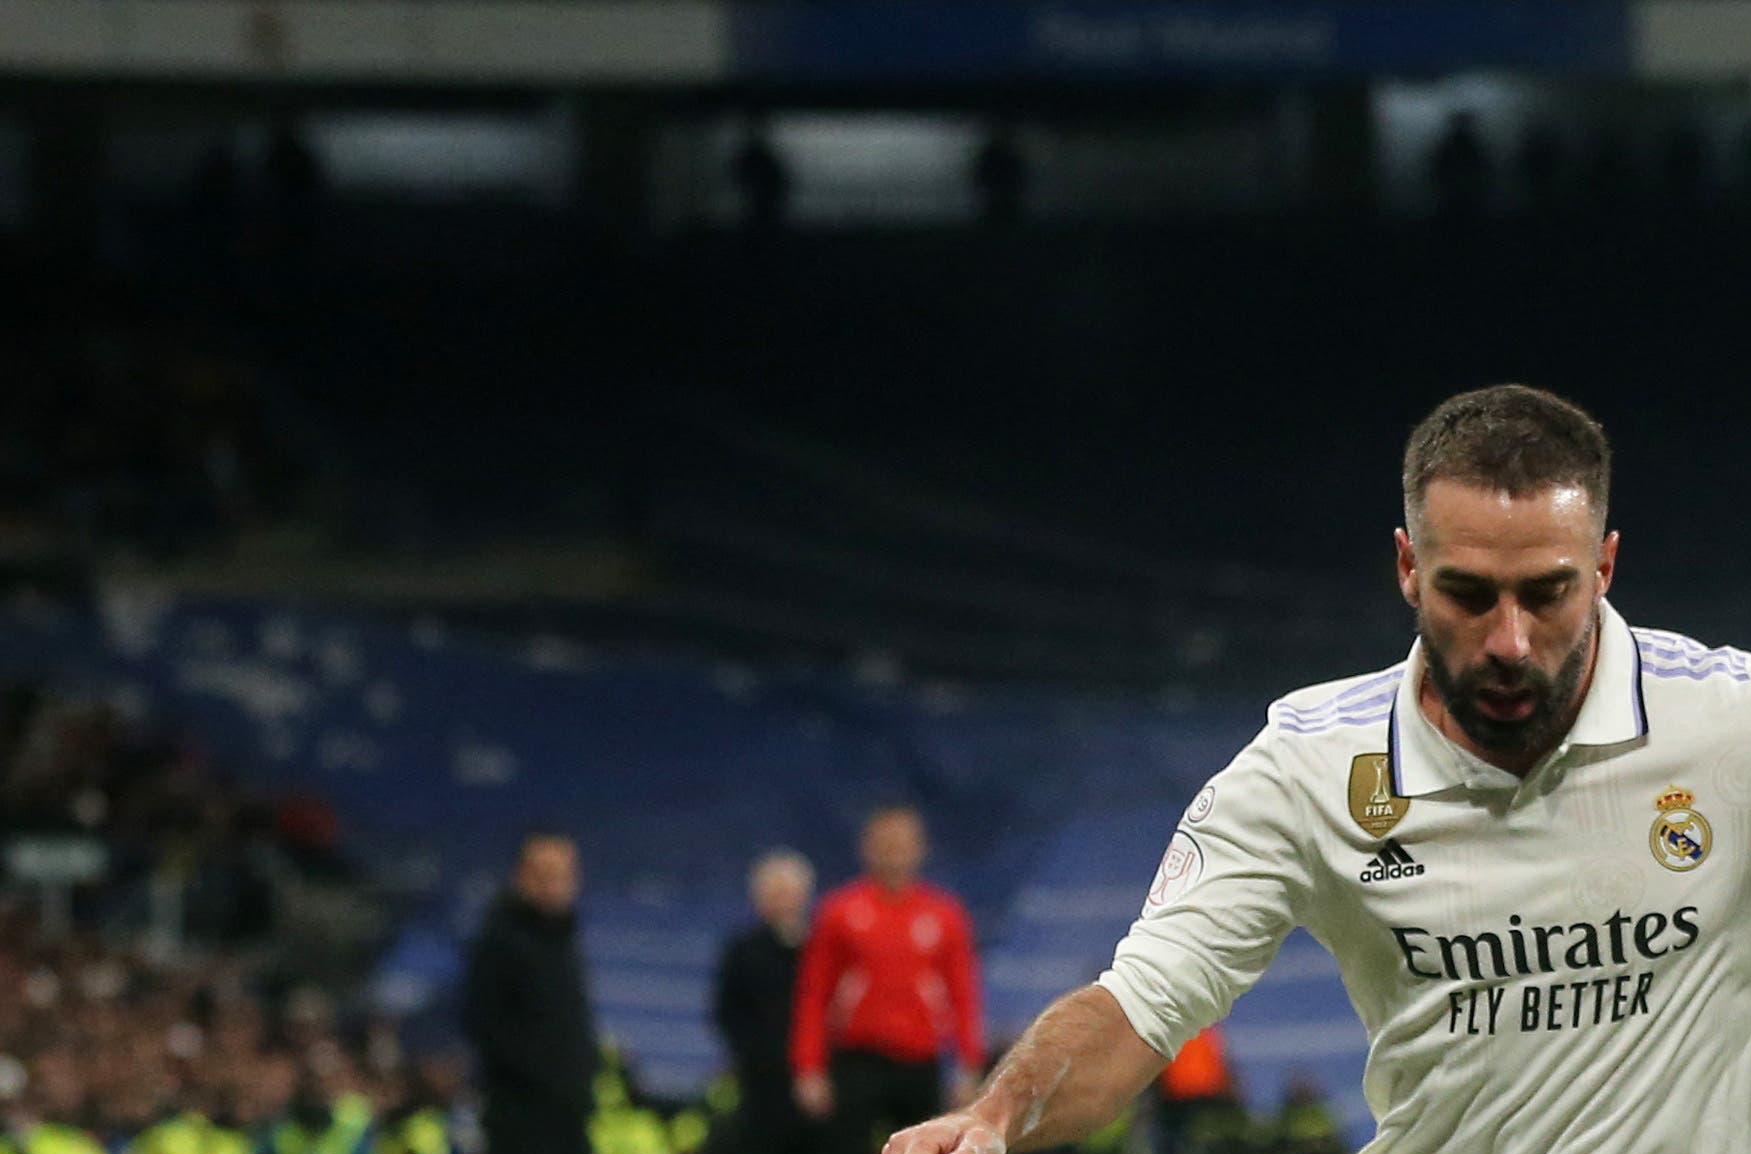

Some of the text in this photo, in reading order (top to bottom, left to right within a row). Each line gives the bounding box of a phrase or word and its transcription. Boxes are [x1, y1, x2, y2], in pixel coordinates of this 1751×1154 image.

[1365, 804, 1393, 817] FIFA
[1360, 864, 1425, 883] adidas
[1390, 906, 1700, 981] Emirates
[1449, 972, 1654, 1036] FLY BETTER
